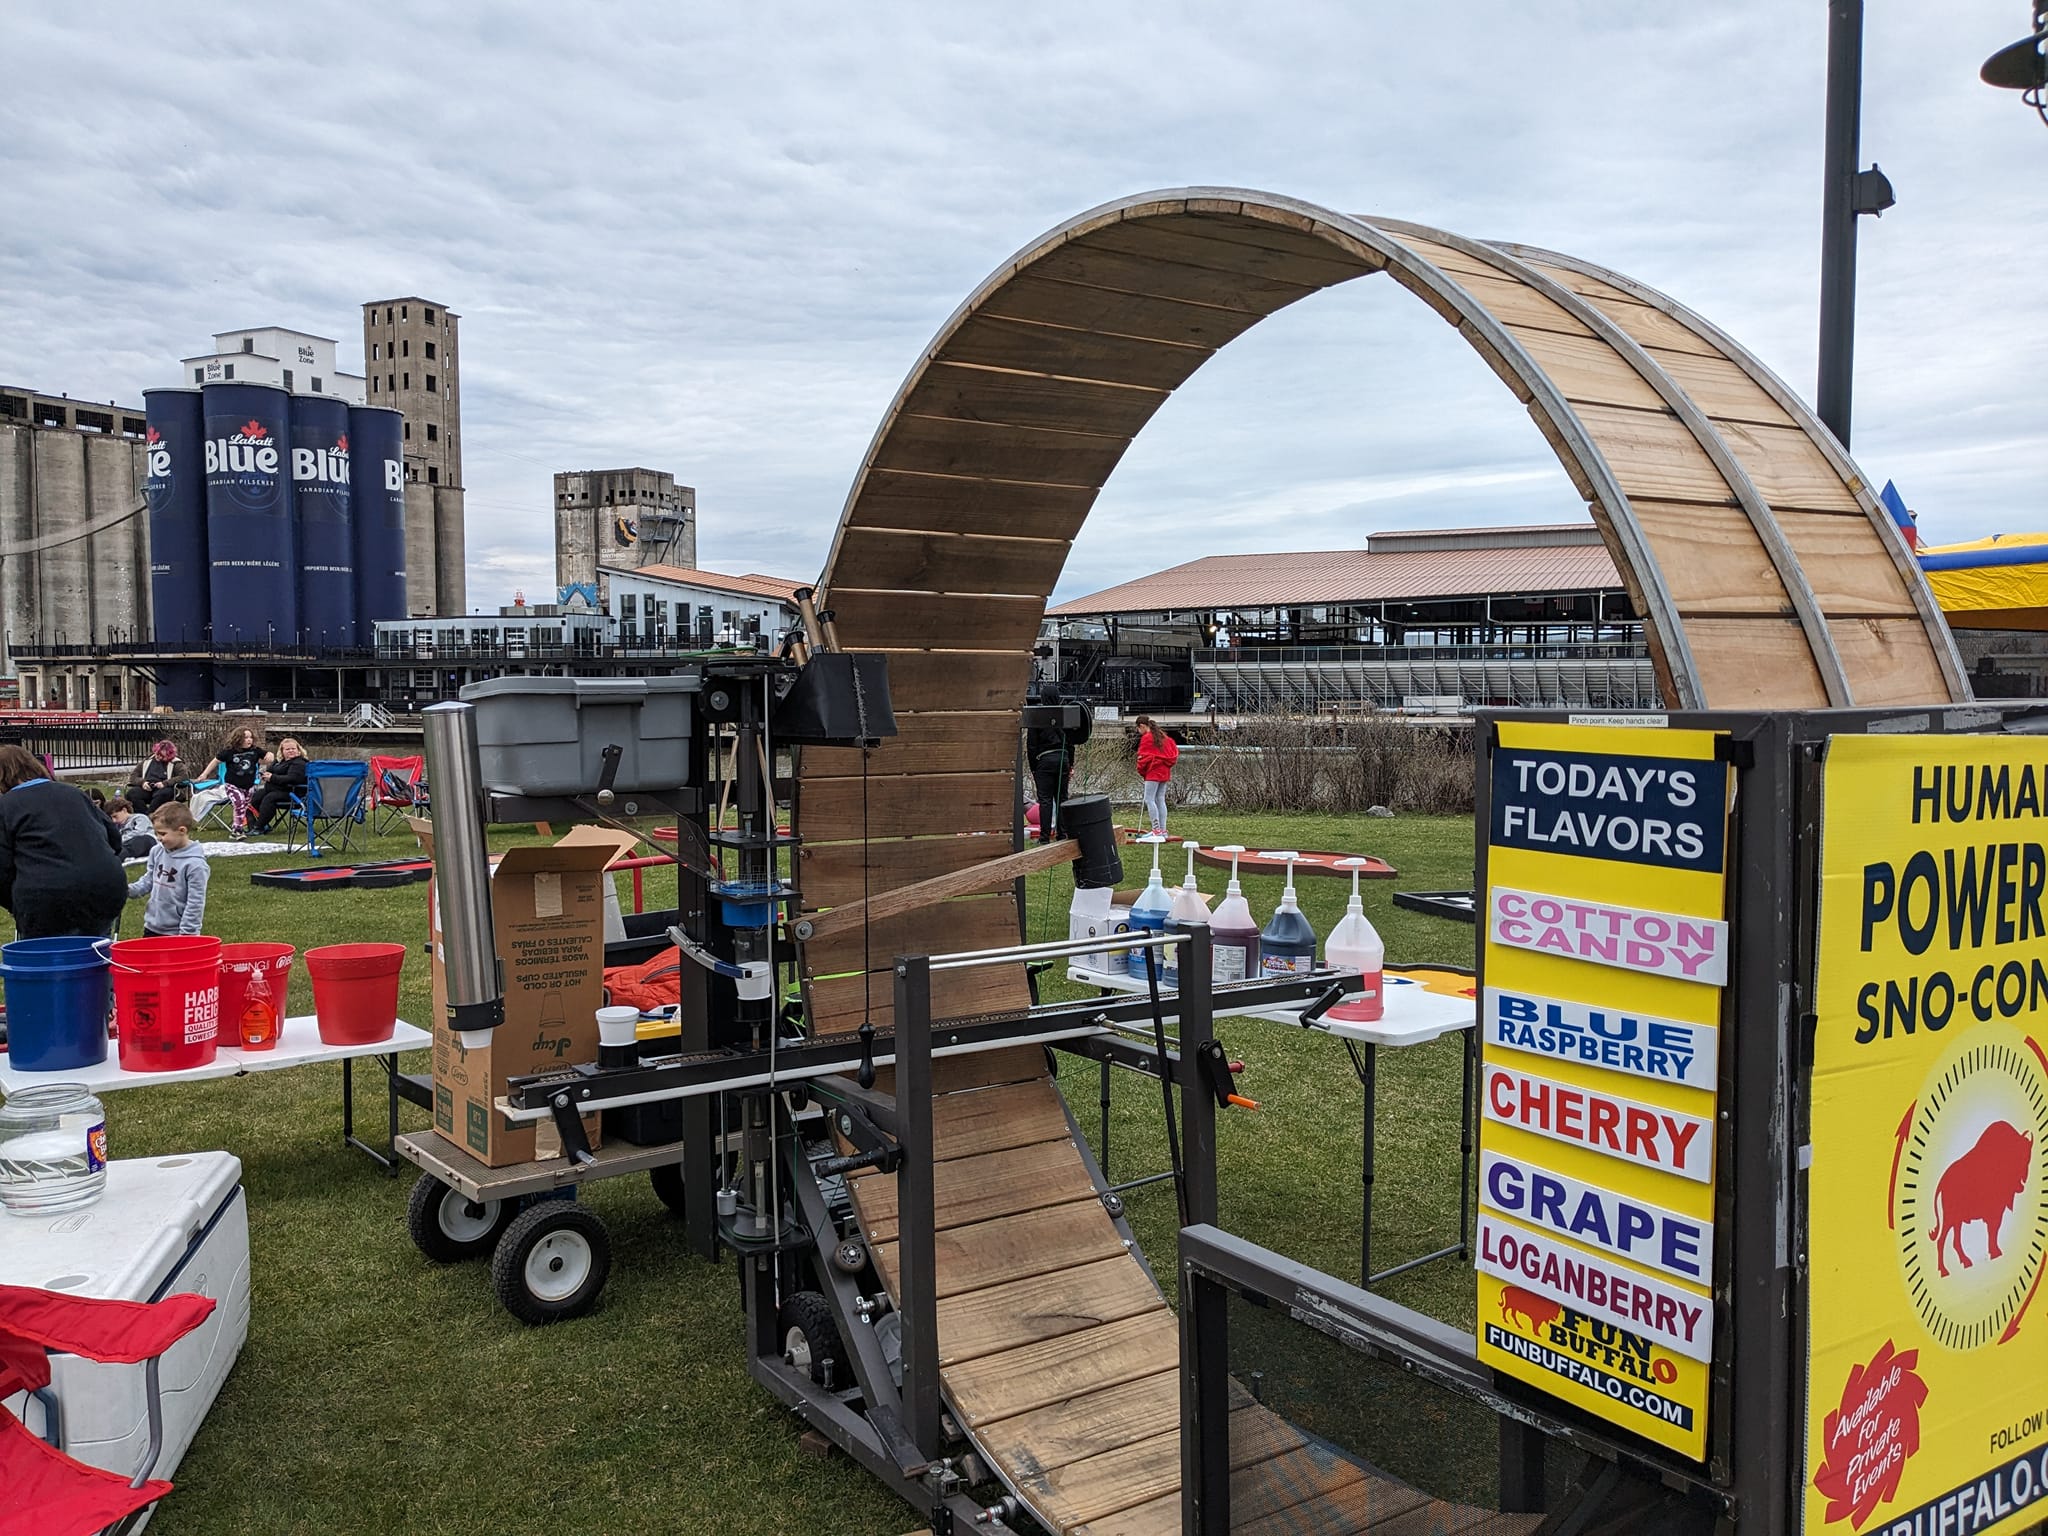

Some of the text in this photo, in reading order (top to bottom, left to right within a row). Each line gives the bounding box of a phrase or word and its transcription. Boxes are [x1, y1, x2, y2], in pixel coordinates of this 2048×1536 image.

[207, 364, 221, 372] Blue
[298, 347, 315, 357] Blue
[299, 356, 315, 364] Zone
[205, 438, 278, 474] Blue
[228, 434, 274, 446] Labatt
[1608, 717, 1624, 725] Keep
[1626, 717, 1645, 725] hands
[1513, 760, 1696, 807] TODAY'S
[1911, 764, 2048, 824] HUMA
[1503, 805, 1704, 859] FLAVORS
[1498, 894, 1715, 951] COTTON
[1860, 843, 2047, 956] POWER
[521, 944, 583, 957] PARA BEBIDAS
[538, 939, 545, 947] O
[547, 935, 593, 947] CALIENTES
[562, 952, 590, 962] VASOS
[1499, 920, 1714, 976] CANDY
[516, 969, 588, 983] INSULATED CUPS
[523, 981, 548, 991] COLD
[549, 980, 562, 988] OR
[188, 1032, 213, 1042] LOWEST
[1498, 995, 1694, 1054] BLUE
[1498, 1019, 1694, 1080] RASPBERRY
[1490, 1072, 1700, 1169] CHERRY
[1488, 1162, 1700, 1277] GRAPE
[1482, 1226, 1703, 1344] LOGANBERRY
[1549, 1323, 1678, 1385] BUFFALO
[1562, 1307, 1653, 1362] FUN
[1489, 1326, 1682, 1425] FUNBUFFALO.COM
[1832, 1365, 1901, 1449] Available
[1990, 1410, 2043, 1454] FOLLOW
[1846, 1418, 1901, 1485] Private
[1852, 1442, 1902, 1505] Events
